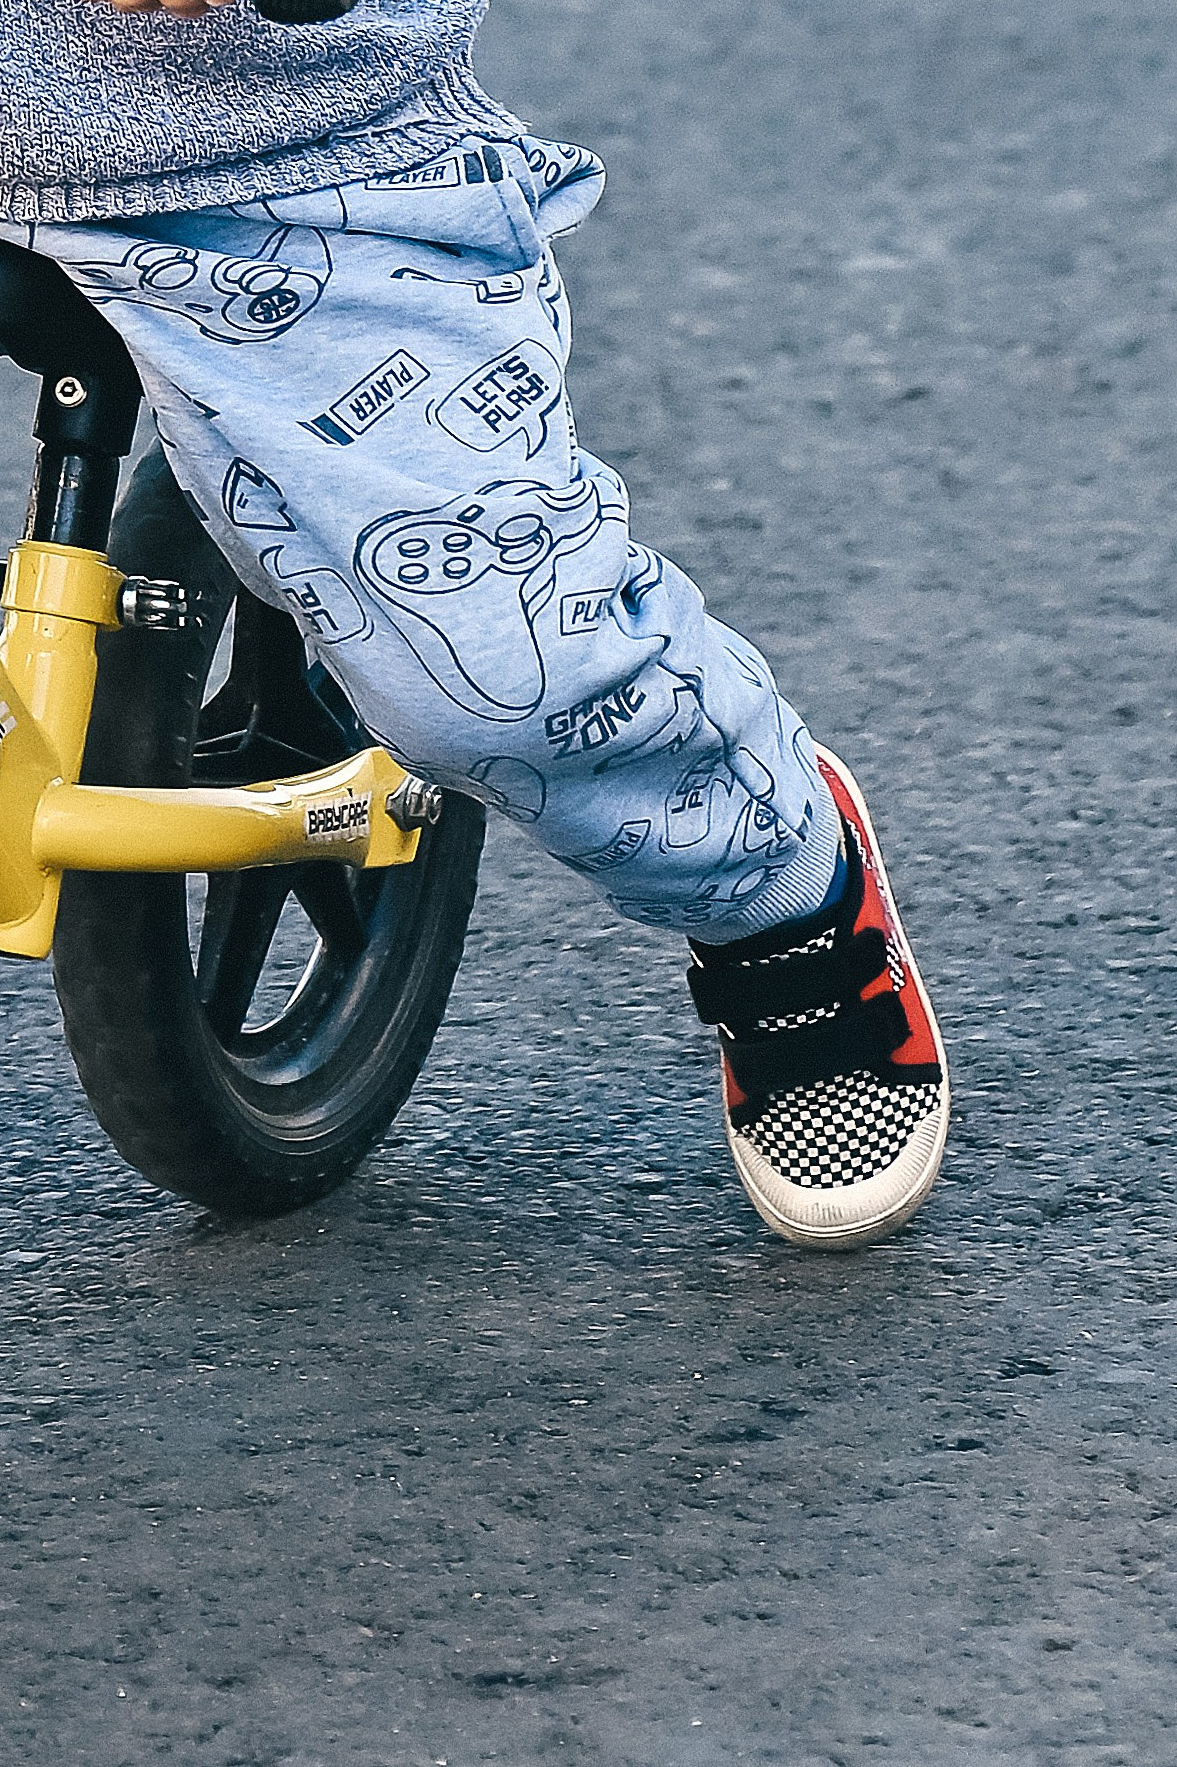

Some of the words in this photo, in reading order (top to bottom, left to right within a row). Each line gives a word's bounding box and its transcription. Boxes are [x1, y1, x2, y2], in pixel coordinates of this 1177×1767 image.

[348, 361, 414, 422] PLAYER
[459, 355, 530, 414] LET'S
[482, 372, 550, 434] PLAY!
[548, 685, 647, 760] ZONE
[307, 799, 368, 835] BABYCARE
